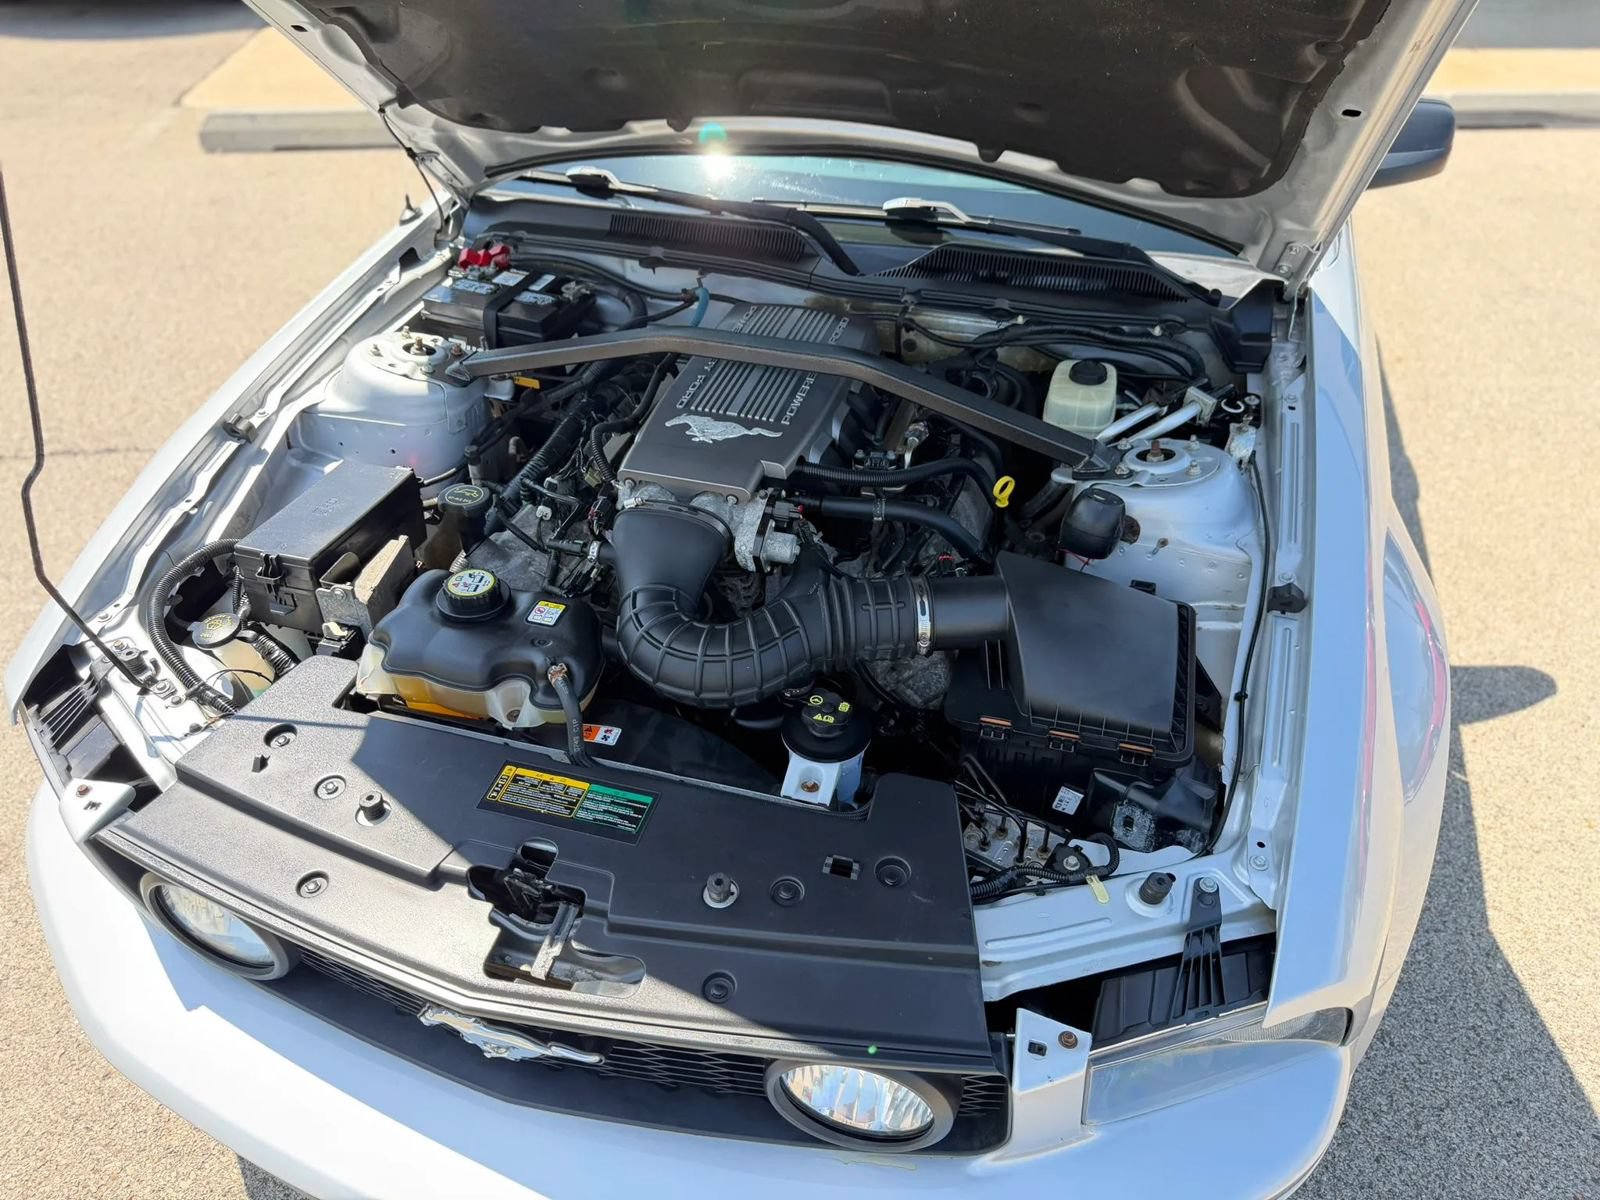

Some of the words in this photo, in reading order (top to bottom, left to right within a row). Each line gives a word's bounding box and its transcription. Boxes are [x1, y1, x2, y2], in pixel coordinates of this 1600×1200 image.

[676, 375, 706, 409] FORD
[781, 371, 818, 425] POWERE
[827, 317, 850, 345] FORD
